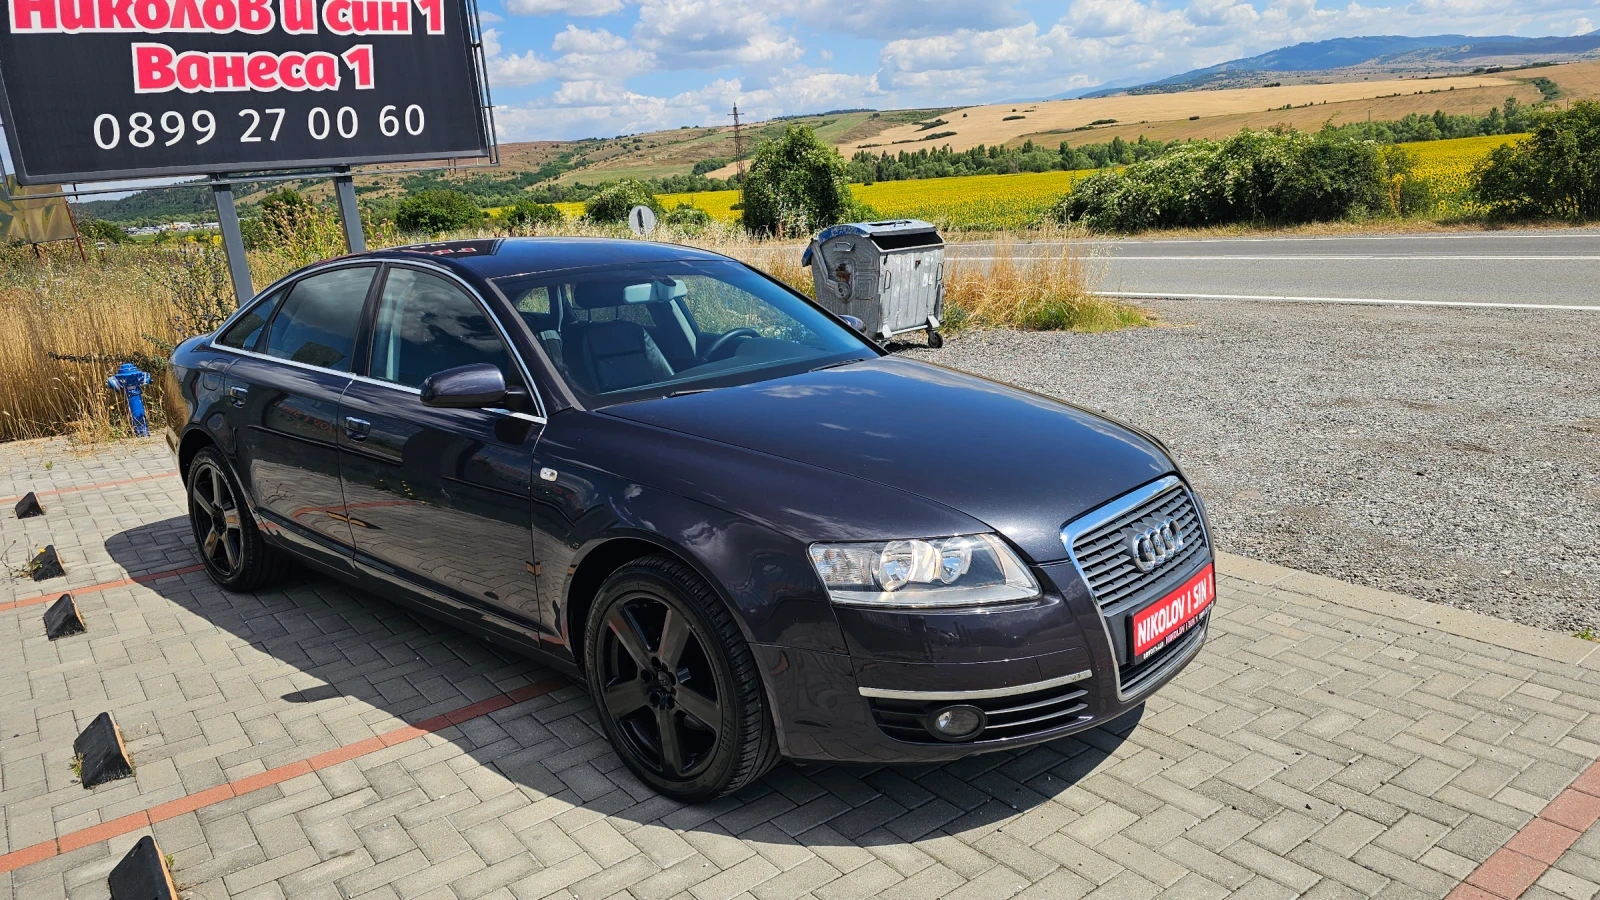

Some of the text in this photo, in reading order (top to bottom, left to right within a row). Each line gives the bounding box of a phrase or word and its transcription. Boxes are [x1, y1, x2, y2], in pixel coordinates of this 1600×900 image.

[9, 0, 445, 35] Николов и син 1
[131, 43, 375, 93] Ванеса 1
[94, 104, 425, 149] 0899 27 00 60
[1137, 595, 1185, 647] NIKOLOV
[1187, 590, 1191, 614] I
[1193, 578, 1207, 609] SIN
[1208, 573, 1212, 595] 1
